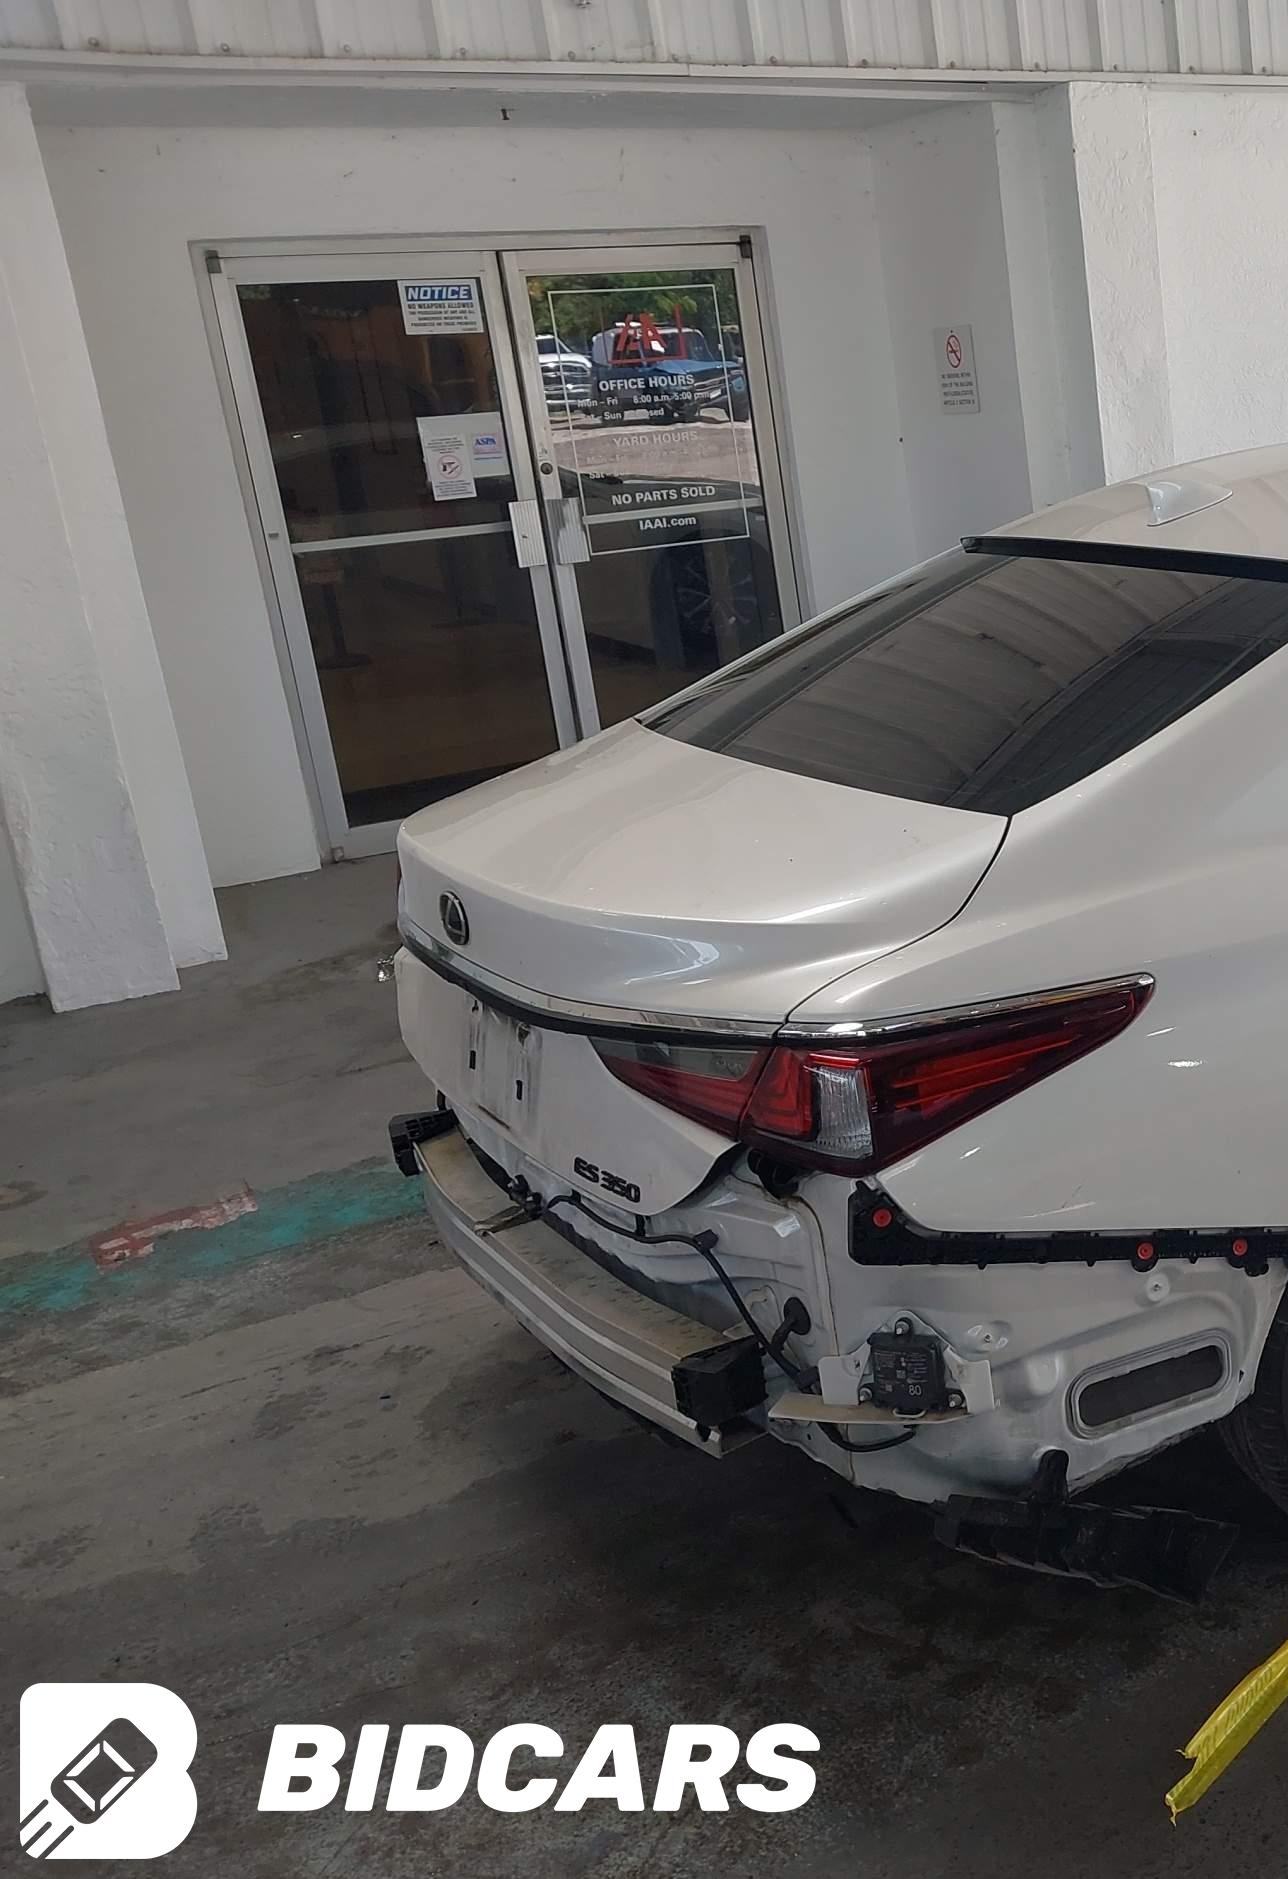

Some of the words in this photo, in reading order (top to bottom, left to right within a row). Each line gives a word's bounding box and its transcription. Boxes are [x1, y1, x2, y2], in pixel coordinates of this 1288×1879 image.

[407, 286, 470, 300] NOTICE
[598, 377, 646, 392] OFFICE
[649, 374, 695, 389] HOURS
[606, 396, 618, 406] Fri
[603, 411, 622, 420] Sun
[612, 434, 649, 448] YARD
[651, 430, 699, 444] HOURS
[611, 493, 632, 506] NO
[635, 489, 677, 503] PARTS
[680, 485, 716, 498] SOLD
[638, 516, 697, 530] IAAI.com
[573, 1156, 600, 1184] ES
[600, 1169, 641, 1203] 350
[908, 1384, 922, 1396] 80
